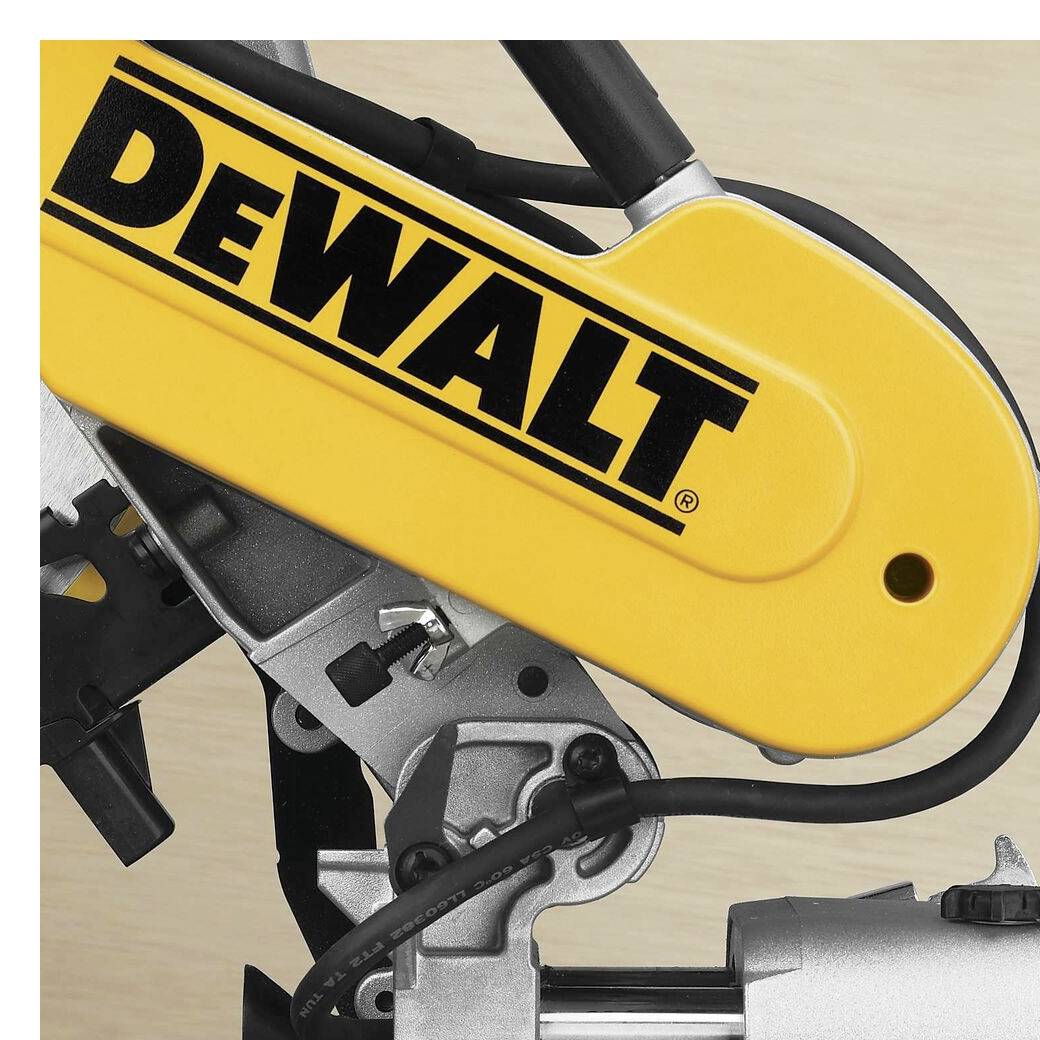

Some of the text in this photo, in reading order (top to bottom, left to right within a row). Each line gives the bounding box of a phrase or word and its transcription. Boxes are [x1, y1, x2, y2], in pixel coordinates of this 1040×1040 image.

[351, 941, 385, 968] FT2
[323, 971, 347, 988] TA
[300, 992, 324, 1018] TUN
